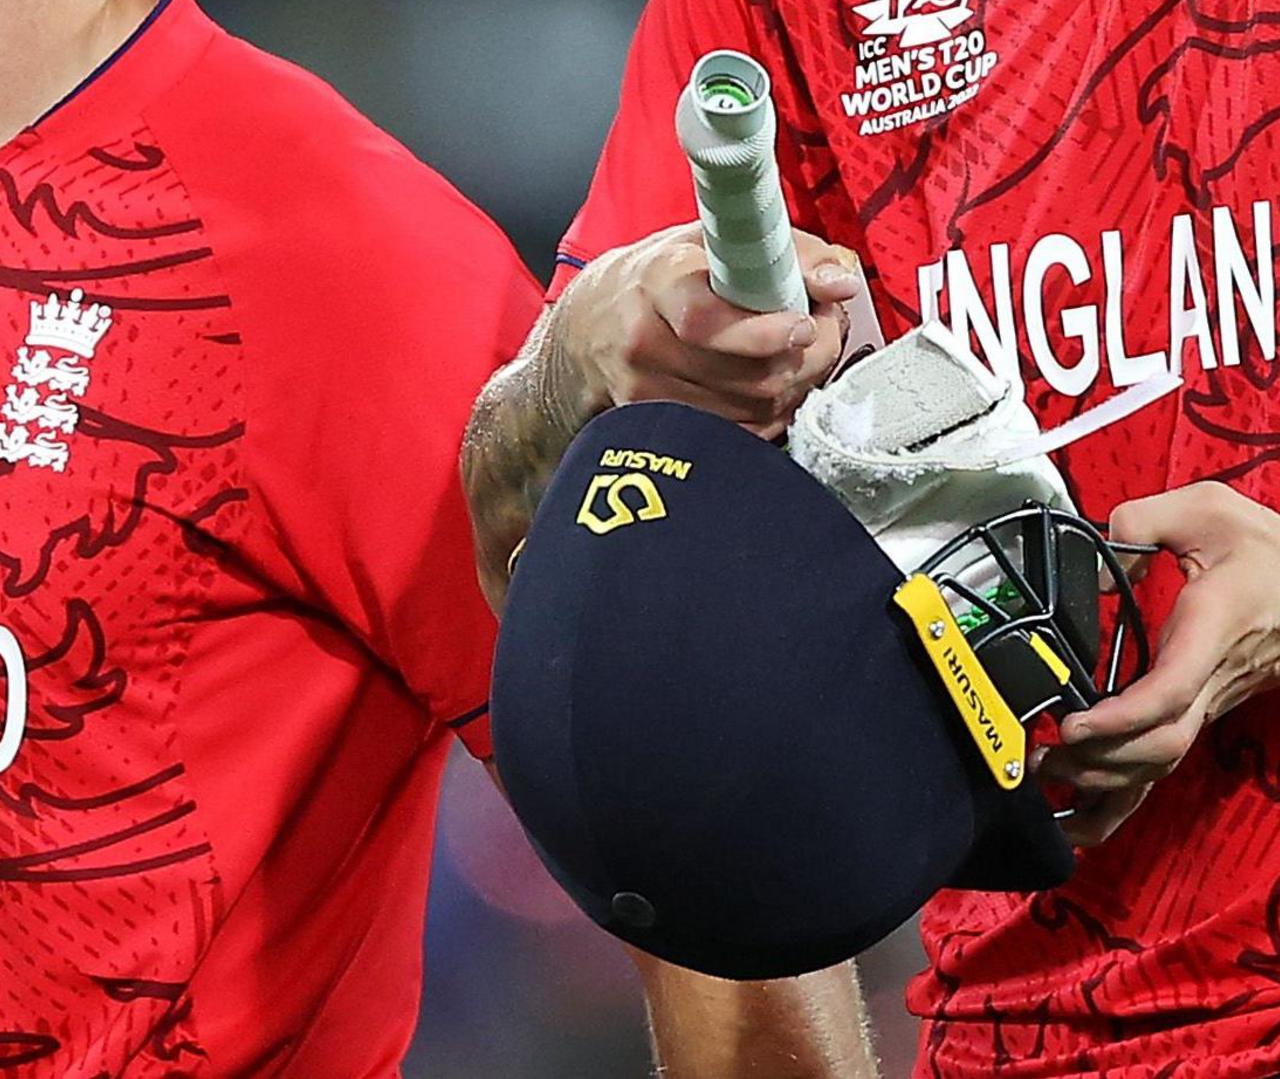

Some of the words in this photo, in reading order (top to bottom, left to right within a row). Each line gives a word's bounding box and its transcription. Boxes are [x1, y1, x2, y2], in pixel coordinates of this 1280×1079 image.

[855, 46, 936, 90] MEN'S
[938, 30, 985, 66] T20
[859, 36, 887, 61] ICC
[841, 72, 942, 117] WORLD
[945, 52, 999, 90] CUP
[859, 98, 946, 136] AUSTRALIA
[600, 449, 693, 481] MASURI
[943, 647, 1004, 754] MASURI
